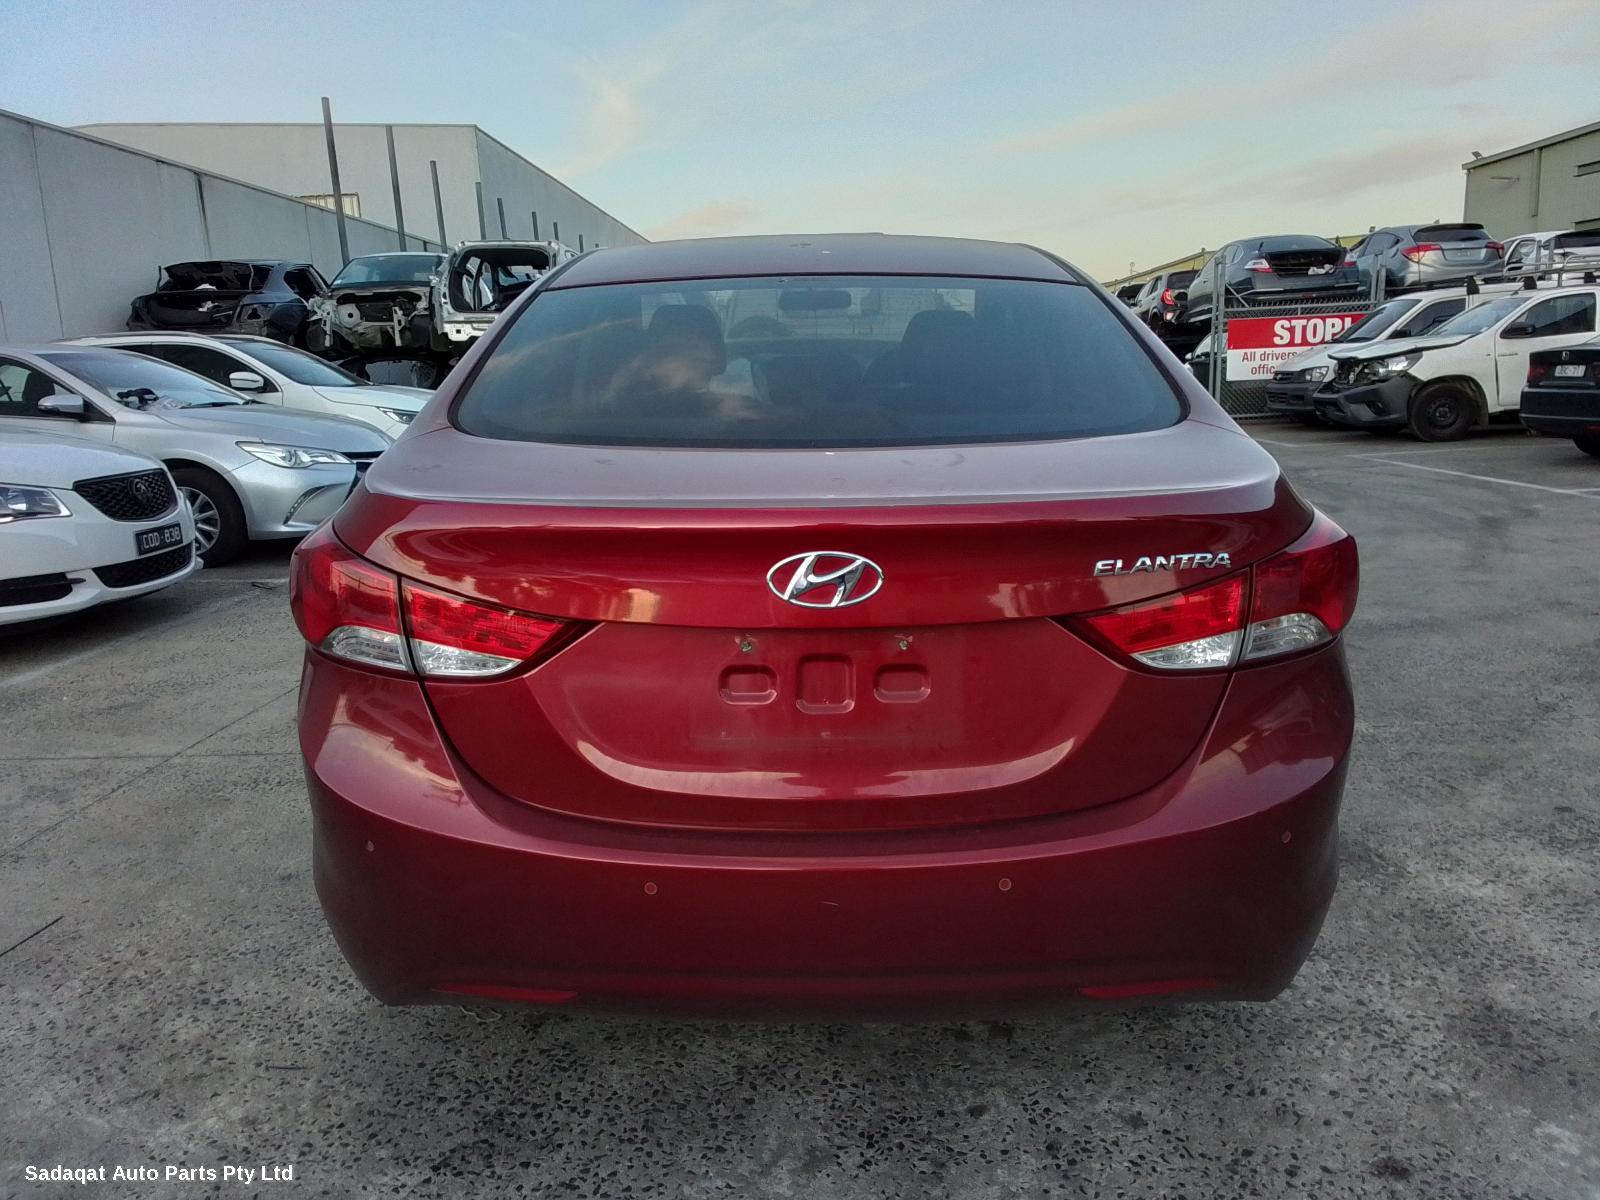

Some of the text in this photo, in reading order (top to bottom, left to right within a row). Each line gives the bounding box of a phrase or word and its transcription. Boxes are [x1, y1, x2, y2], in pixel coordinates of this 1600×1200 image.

[1242, 351, 1256, 362] All
[1251, 363, 1277, 375] offic
[1093, 552, 1231, 577] ELANTRA
